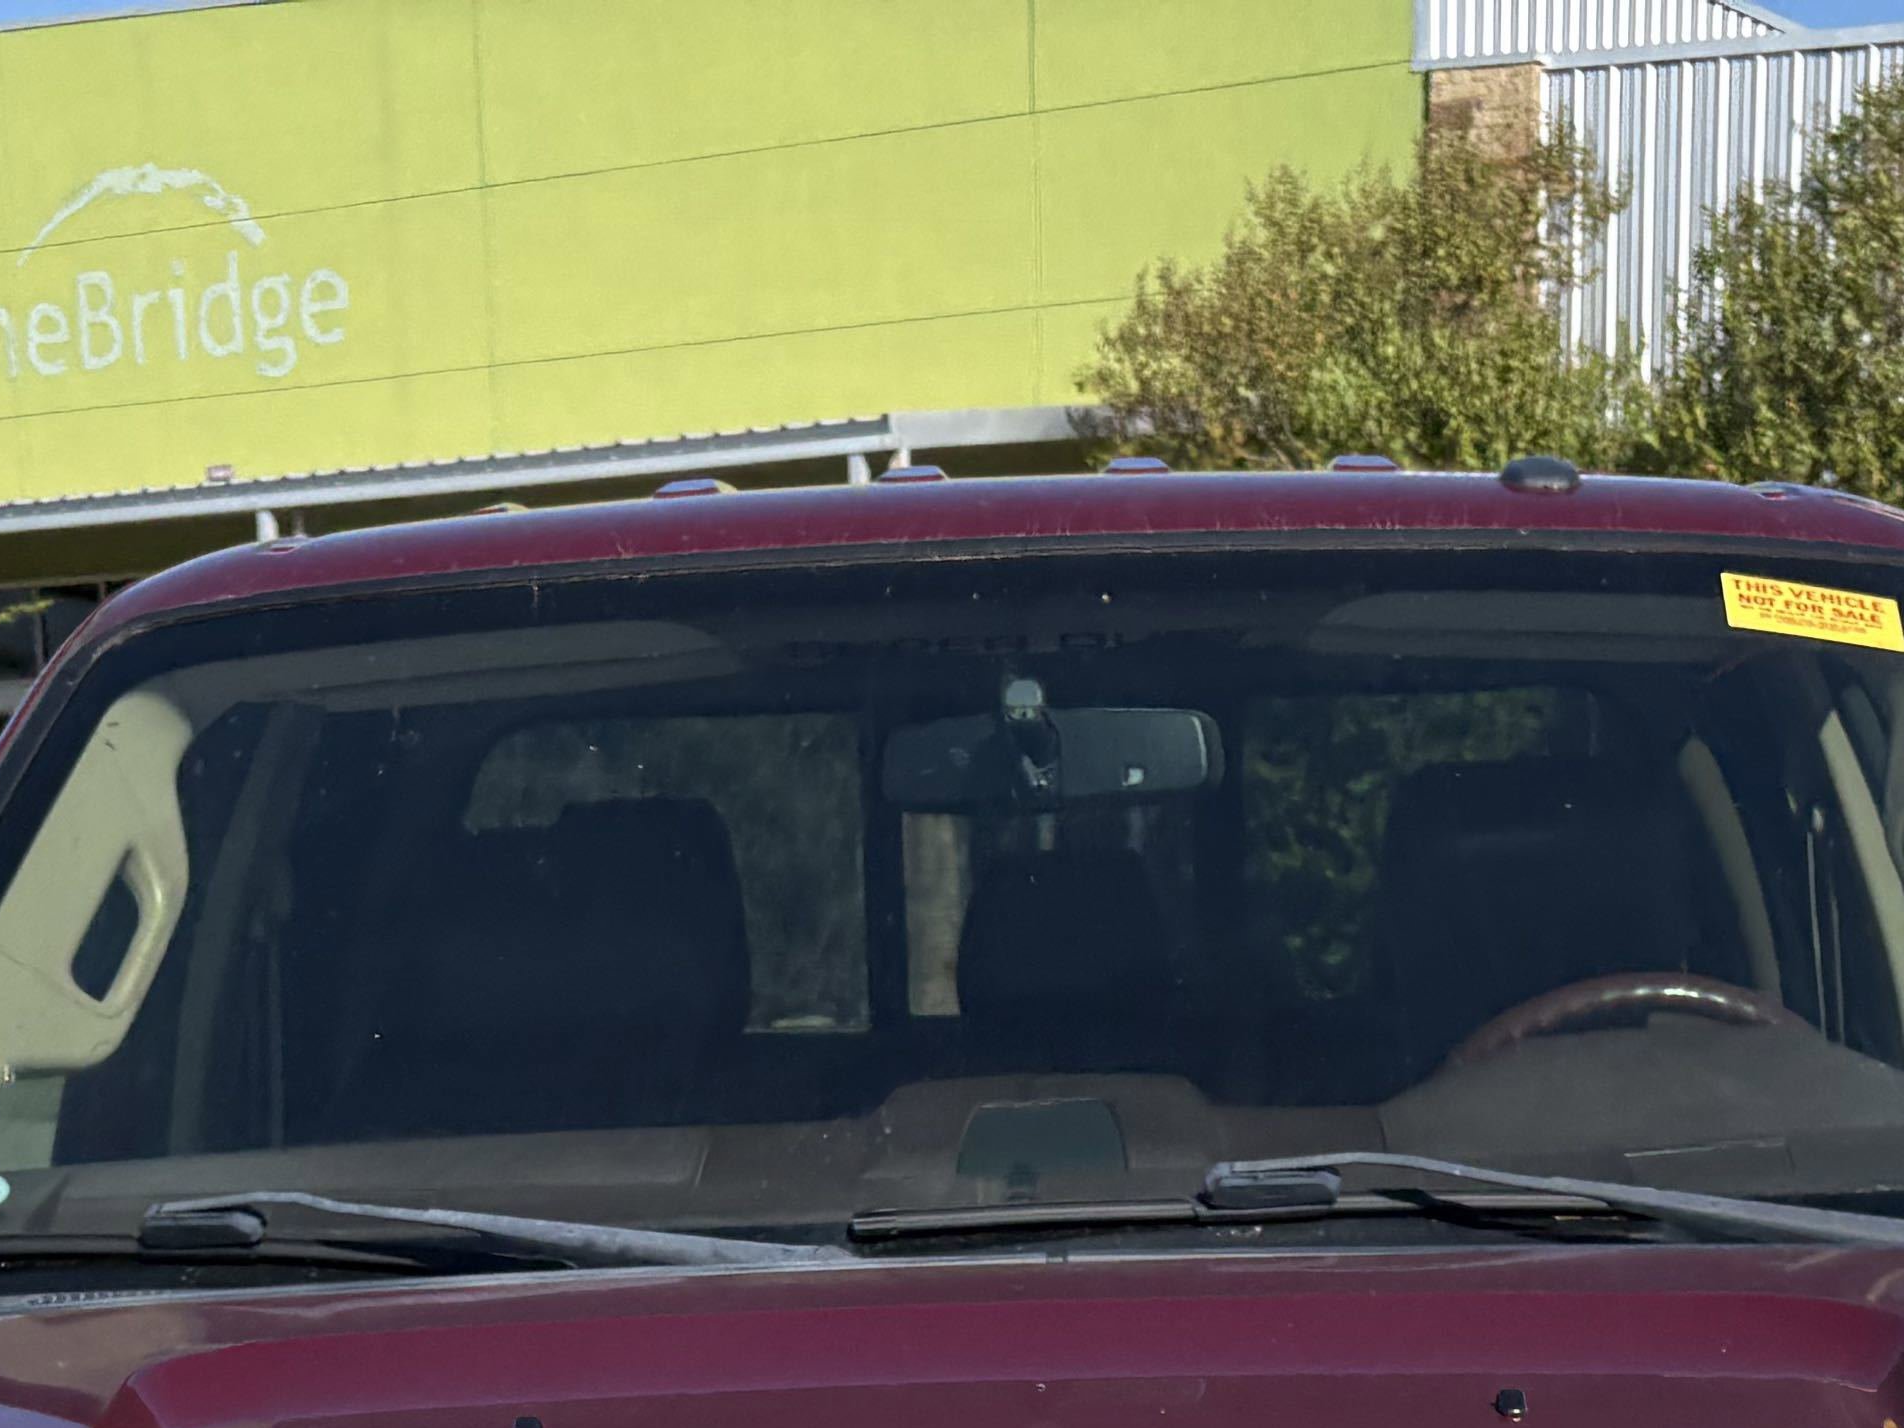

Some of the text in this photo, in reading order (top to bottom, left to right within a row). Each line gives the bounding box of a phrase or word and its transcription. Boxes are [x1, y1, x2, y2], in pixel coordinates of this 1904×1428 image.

[1733, 578, 1886, 614] THIS VEHICLE
[1738, 593, 1776, 609] NOT
[1784, 599, 1825, 616] FOR
[1832, 607, 1882, 623] SALE
